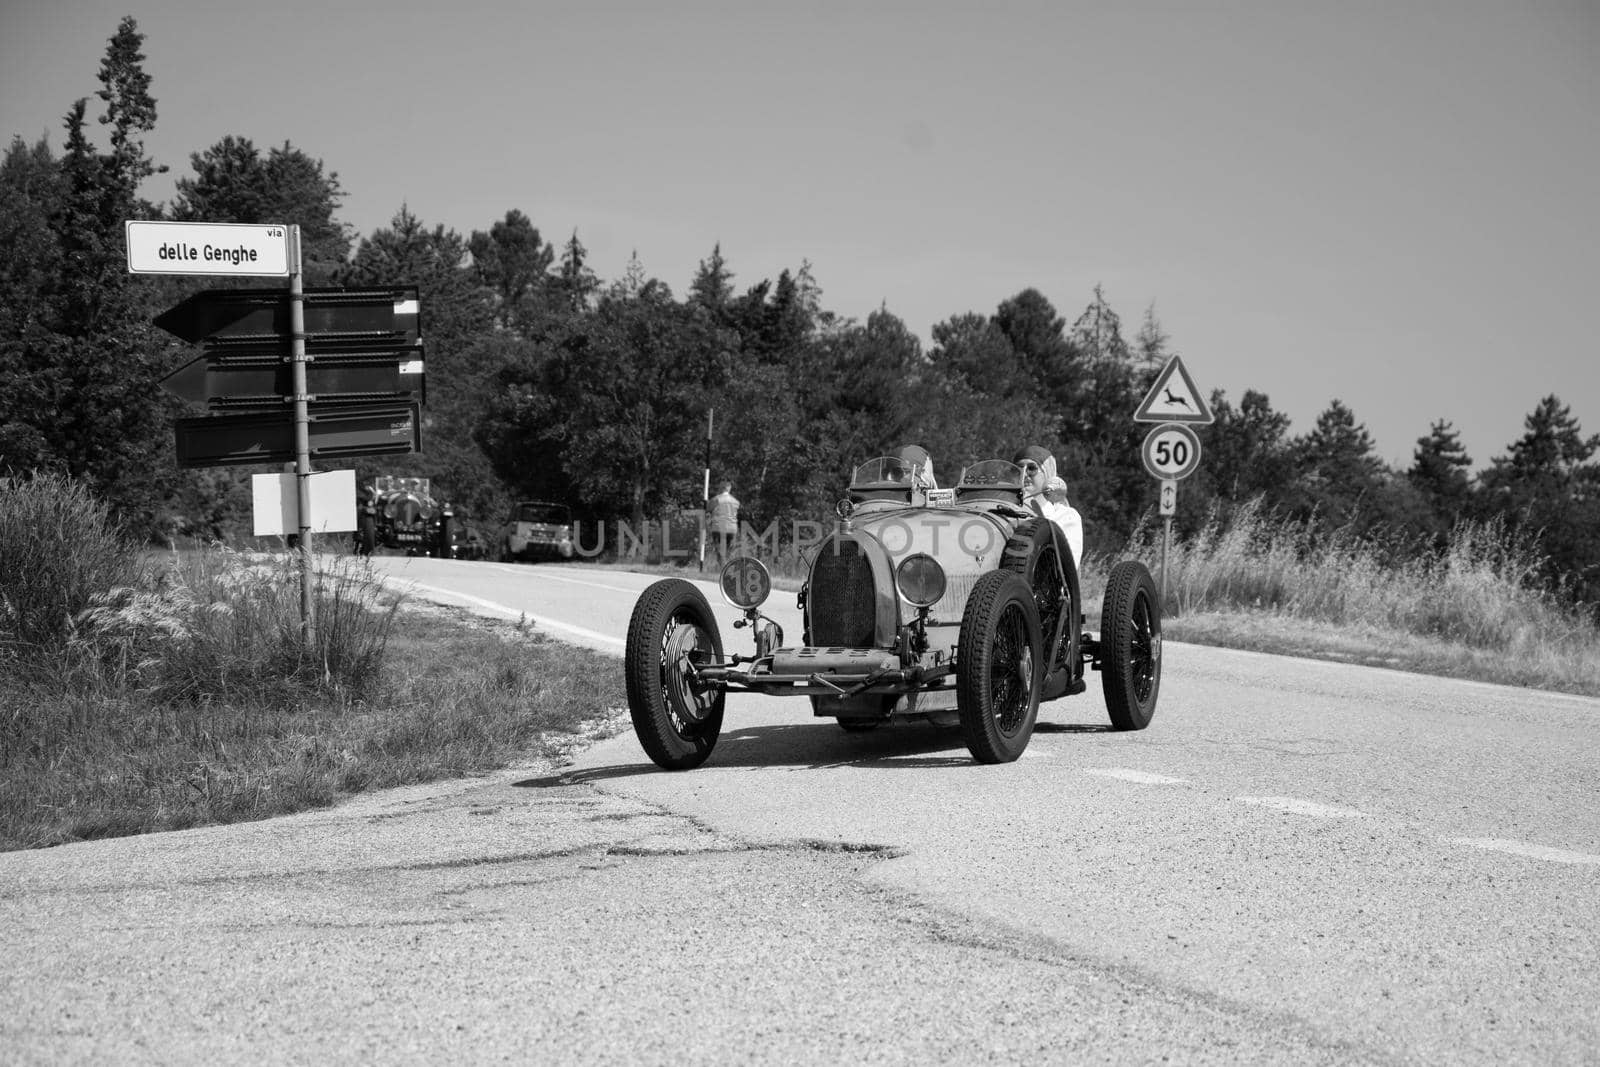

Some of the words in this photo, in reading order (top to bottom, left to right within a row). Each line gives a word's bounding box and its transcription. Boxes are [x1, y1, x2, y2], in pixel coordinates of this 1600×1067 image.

[267, 228, 282, 238] via
[158, 243, 198, 260] delle
[203, 244, 257, 265] Genghe
[1156, 440, 1188, 466] 50
[730, 568, 763, 597] 18
